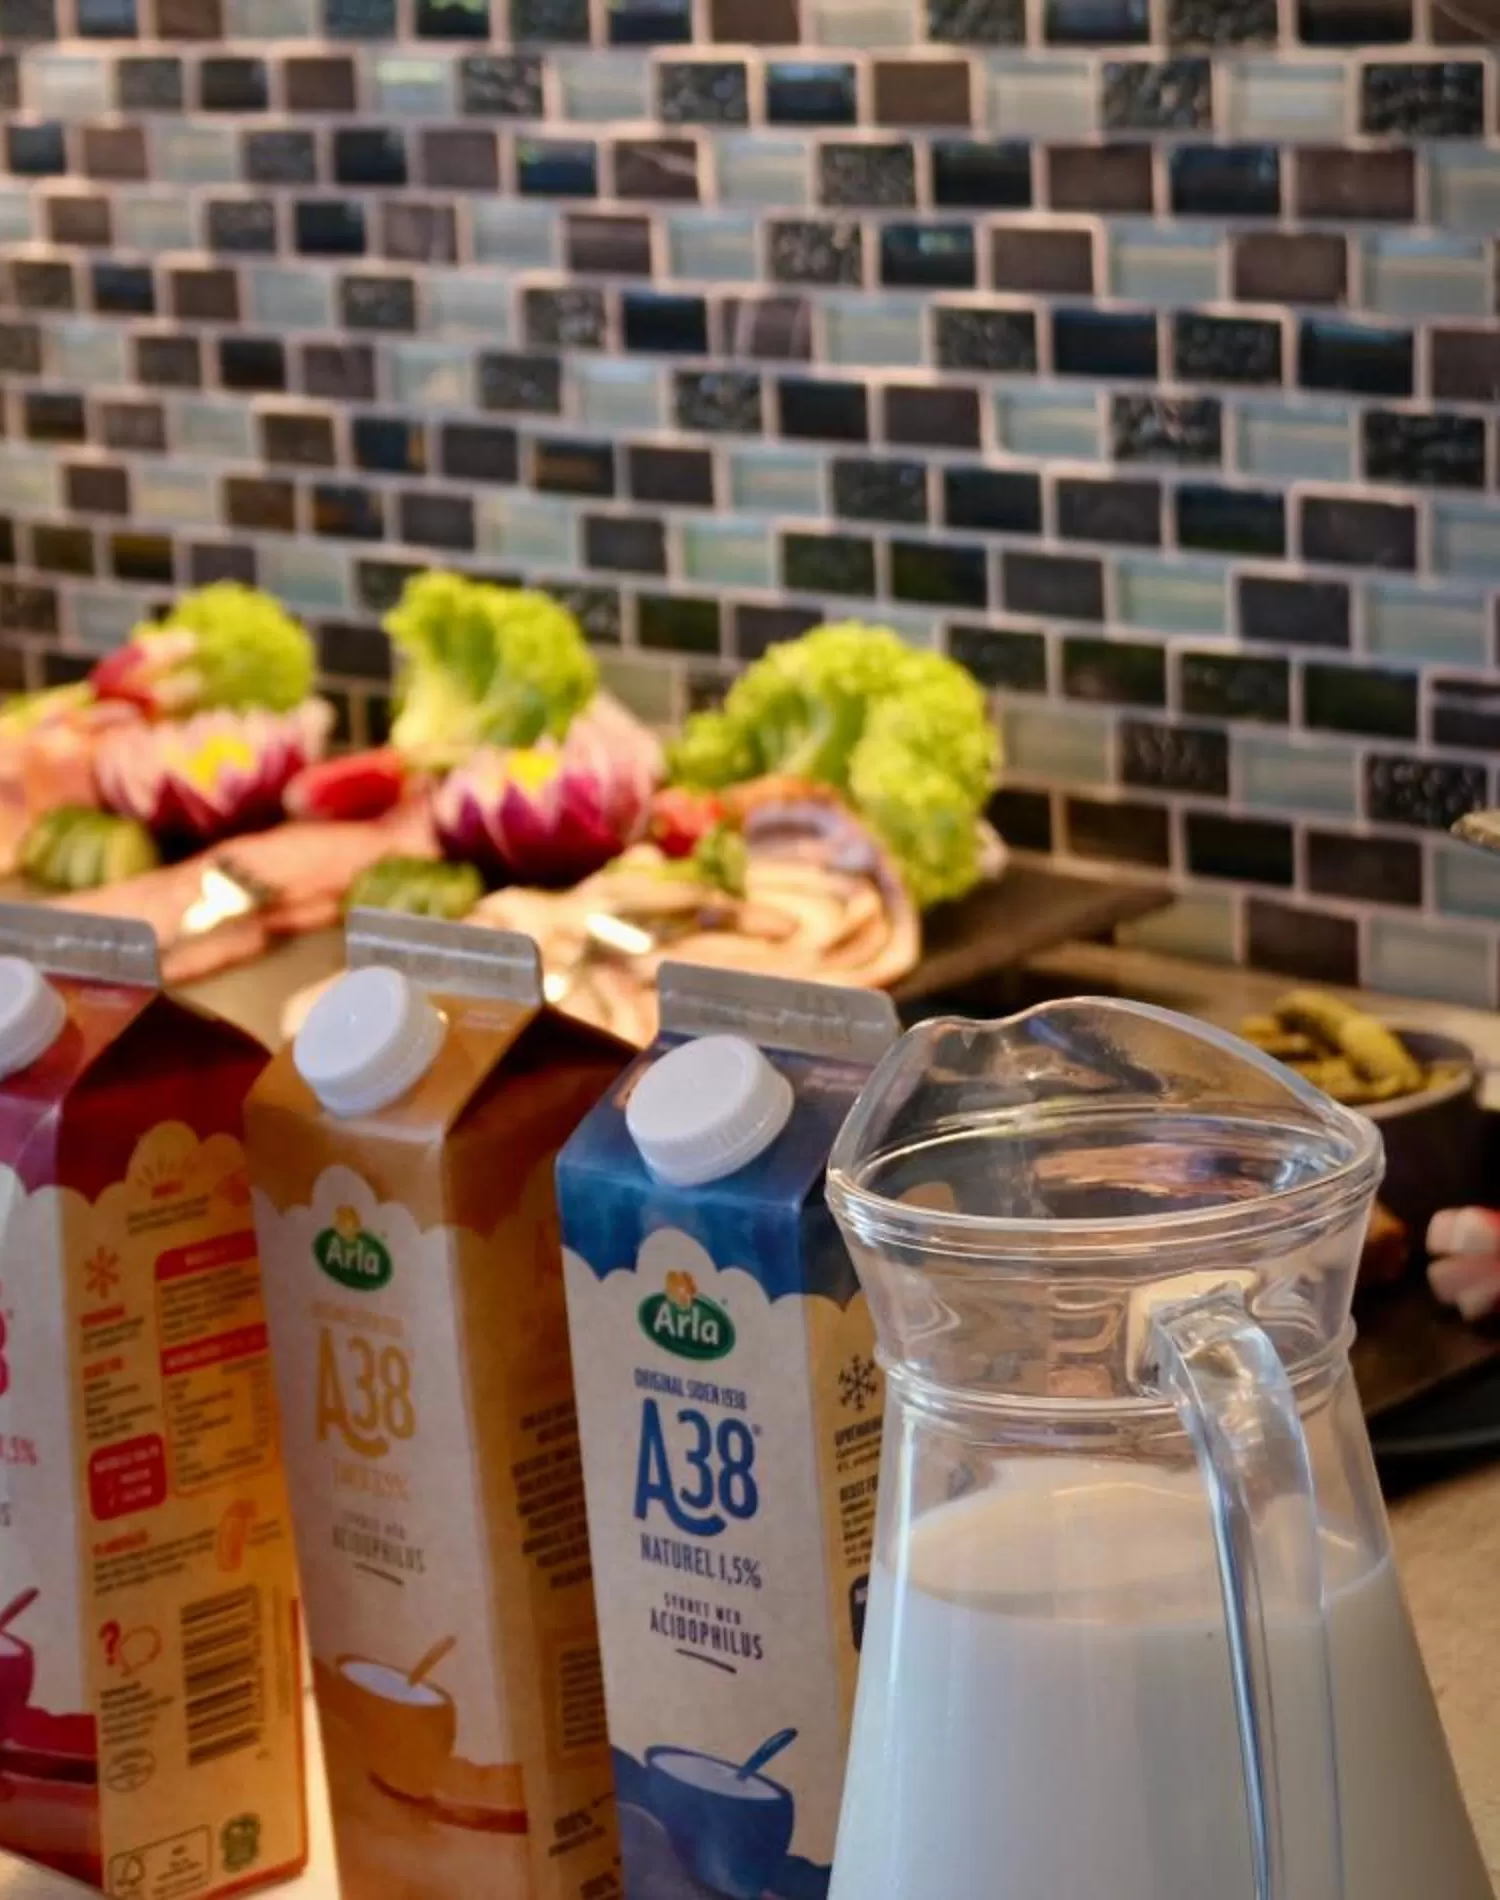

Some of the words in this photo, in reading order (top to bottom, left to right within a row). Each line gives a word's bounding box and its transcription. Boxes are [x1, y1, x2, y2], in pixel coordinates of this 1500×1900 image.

[325, 1241, 380, 1277] Arla
[653, 1305, 721, 1347] Arla
[318, 1326, 417, 1458] A38
[633, 1397, 760, 1537] A38
[640, 1531, 716, 1580] NATUREL
[719, 1551, 763, 1590] 1,5%
[649, 1605, 763, 1661] ACIDOPHILUS
